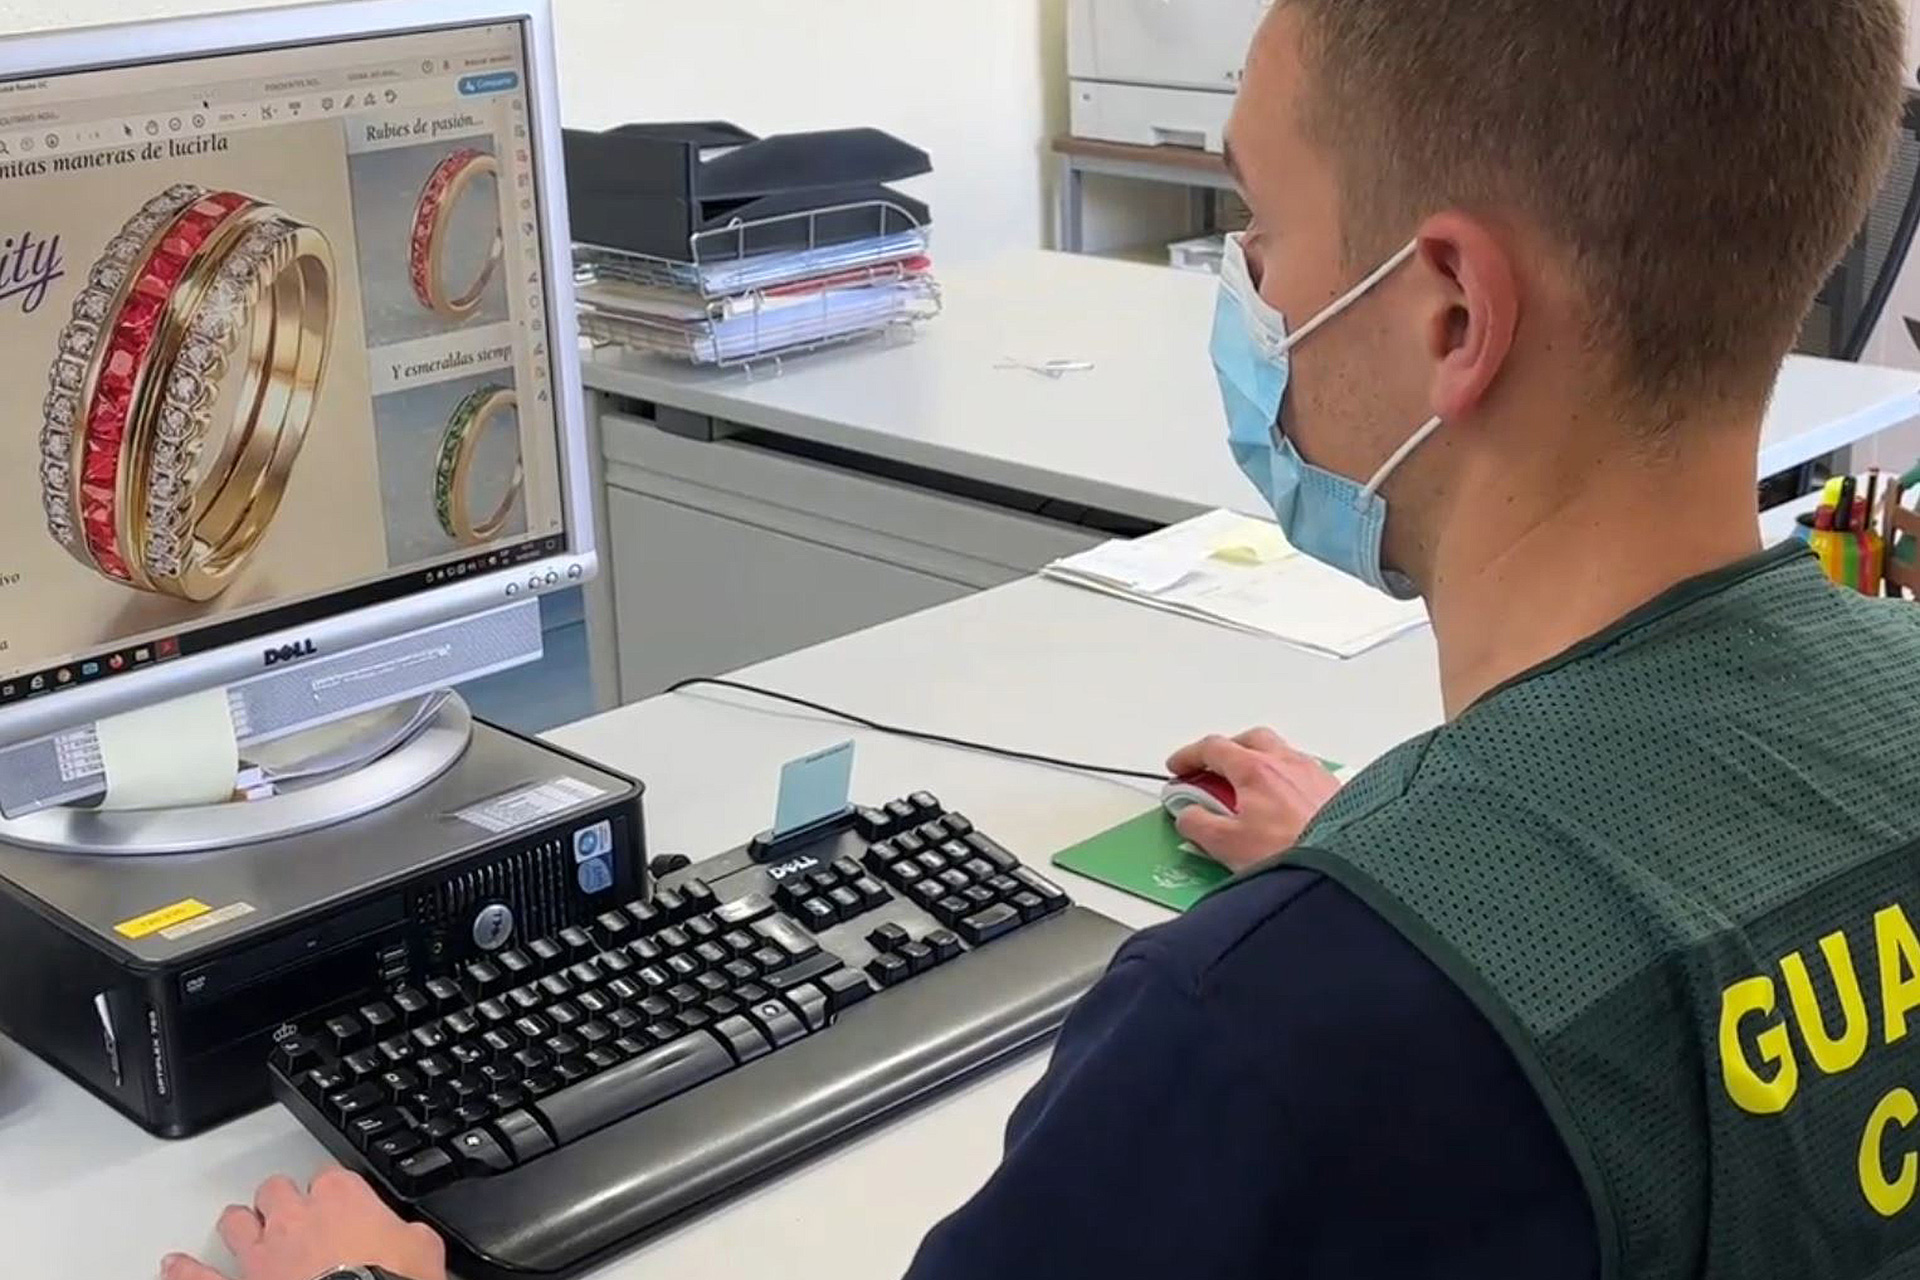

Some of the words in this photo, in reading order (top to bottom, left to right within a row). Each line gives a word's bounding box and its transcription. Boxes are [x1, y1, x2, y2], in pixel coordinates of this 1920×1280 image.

[366, 122, 410, 141] Rubies
[412, 118, 428, 134] de
[53, 149, 135, 172] maneras
[141, 142, 162, 160] de
[169, 133, 228, 157] lucirla
[391, 365, 402, 380] Y
[404, 351, 474, 377] esmeraldas
[264, 638, 318, 666] DELL
[769, 856, 819, 880] DELL
[1718, 903, 1920, 1114] GUA
[1858, 1087, 1920, 1217] C
